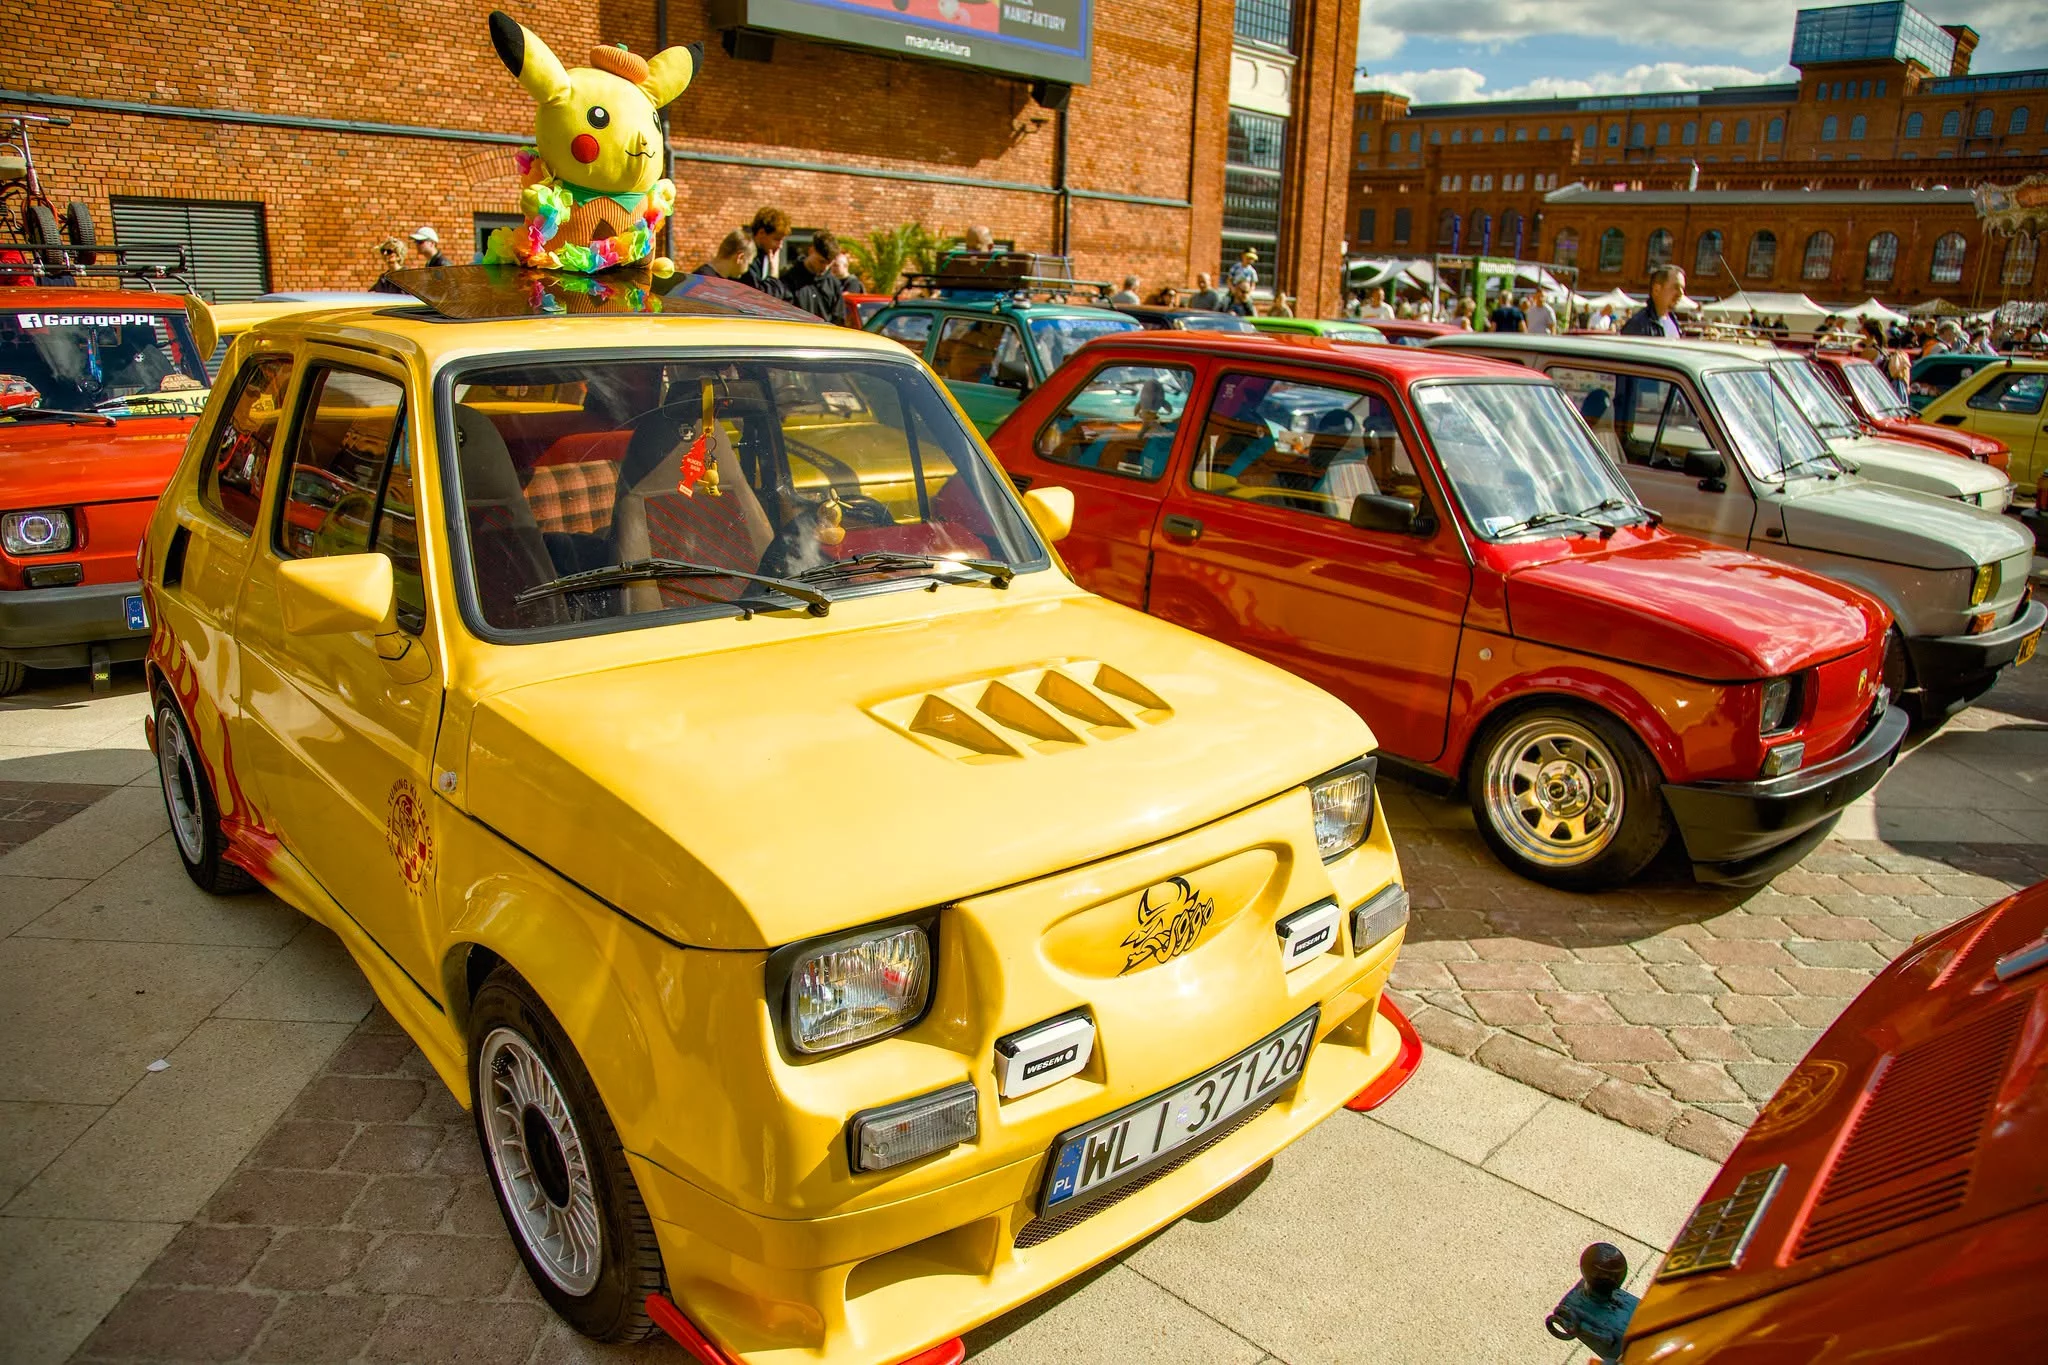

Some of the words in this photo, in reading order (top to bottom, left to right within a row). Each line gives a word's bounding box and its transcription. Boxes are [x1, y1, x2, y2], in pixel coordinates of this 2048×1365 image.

[905, 34, 970, 57] manufaktura
[44, 314, 161, 327] GaragePPL
[146, 398, 188, 415] RAJD
[131, 616, 143, 624] PL
[387, 779, 408, 807] TUNING
[1027, 1055, 1064, 1076] WESEM
[1187, 1025, 1309, 1132] 37126
[1053, 1179, 1072, 1194] PL
